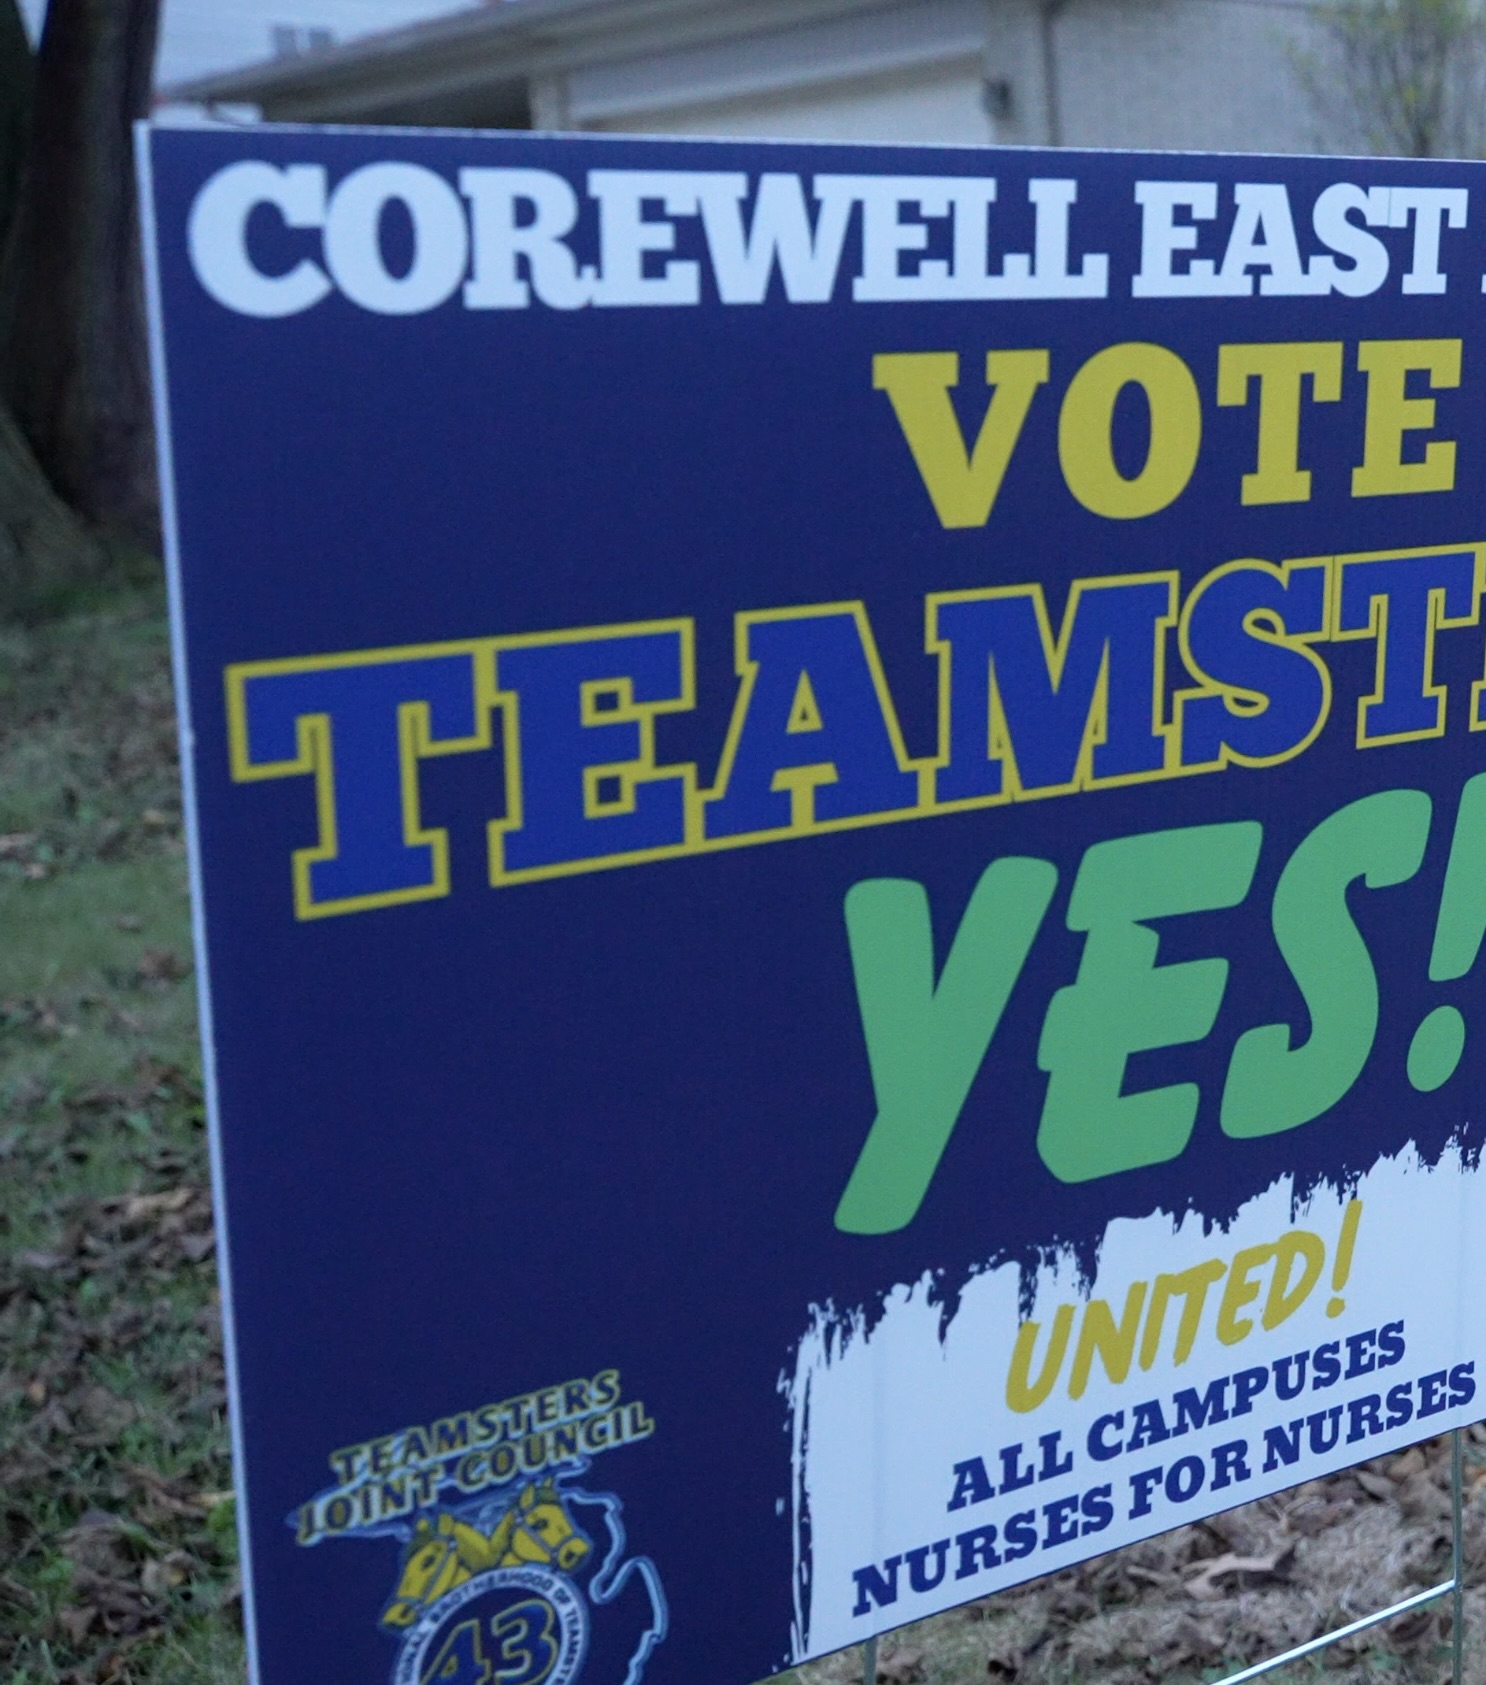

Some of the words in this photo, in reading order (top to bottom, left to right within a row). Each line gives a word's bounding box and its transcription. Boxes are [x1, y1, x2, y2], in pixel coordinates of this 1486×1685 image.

[188, 160, 1108, 318] COREWELL
[1132, 181, 1469, 298] EAST
[872, 338, 1464, 529] VOTE
[1005, 1199, 1363, 1414] UNITED!
[296, 1464, 447, 1548] JOINT
[455, 1401, 655, 1494] COUNCIL
[330, 1369, 621, 1487] TEAMSTERS
[851, 1482, 1115, 1619] NURSES
[1128, 1438, 1253, 1522] FOR
[1262, 1359, 1477, 1475] NURSES
[946, 1429, 1075, 1513] ALL
[1086, 1319, 1407, 1463] CAMPUSES
[417, 1598, 559, 1685] 43
